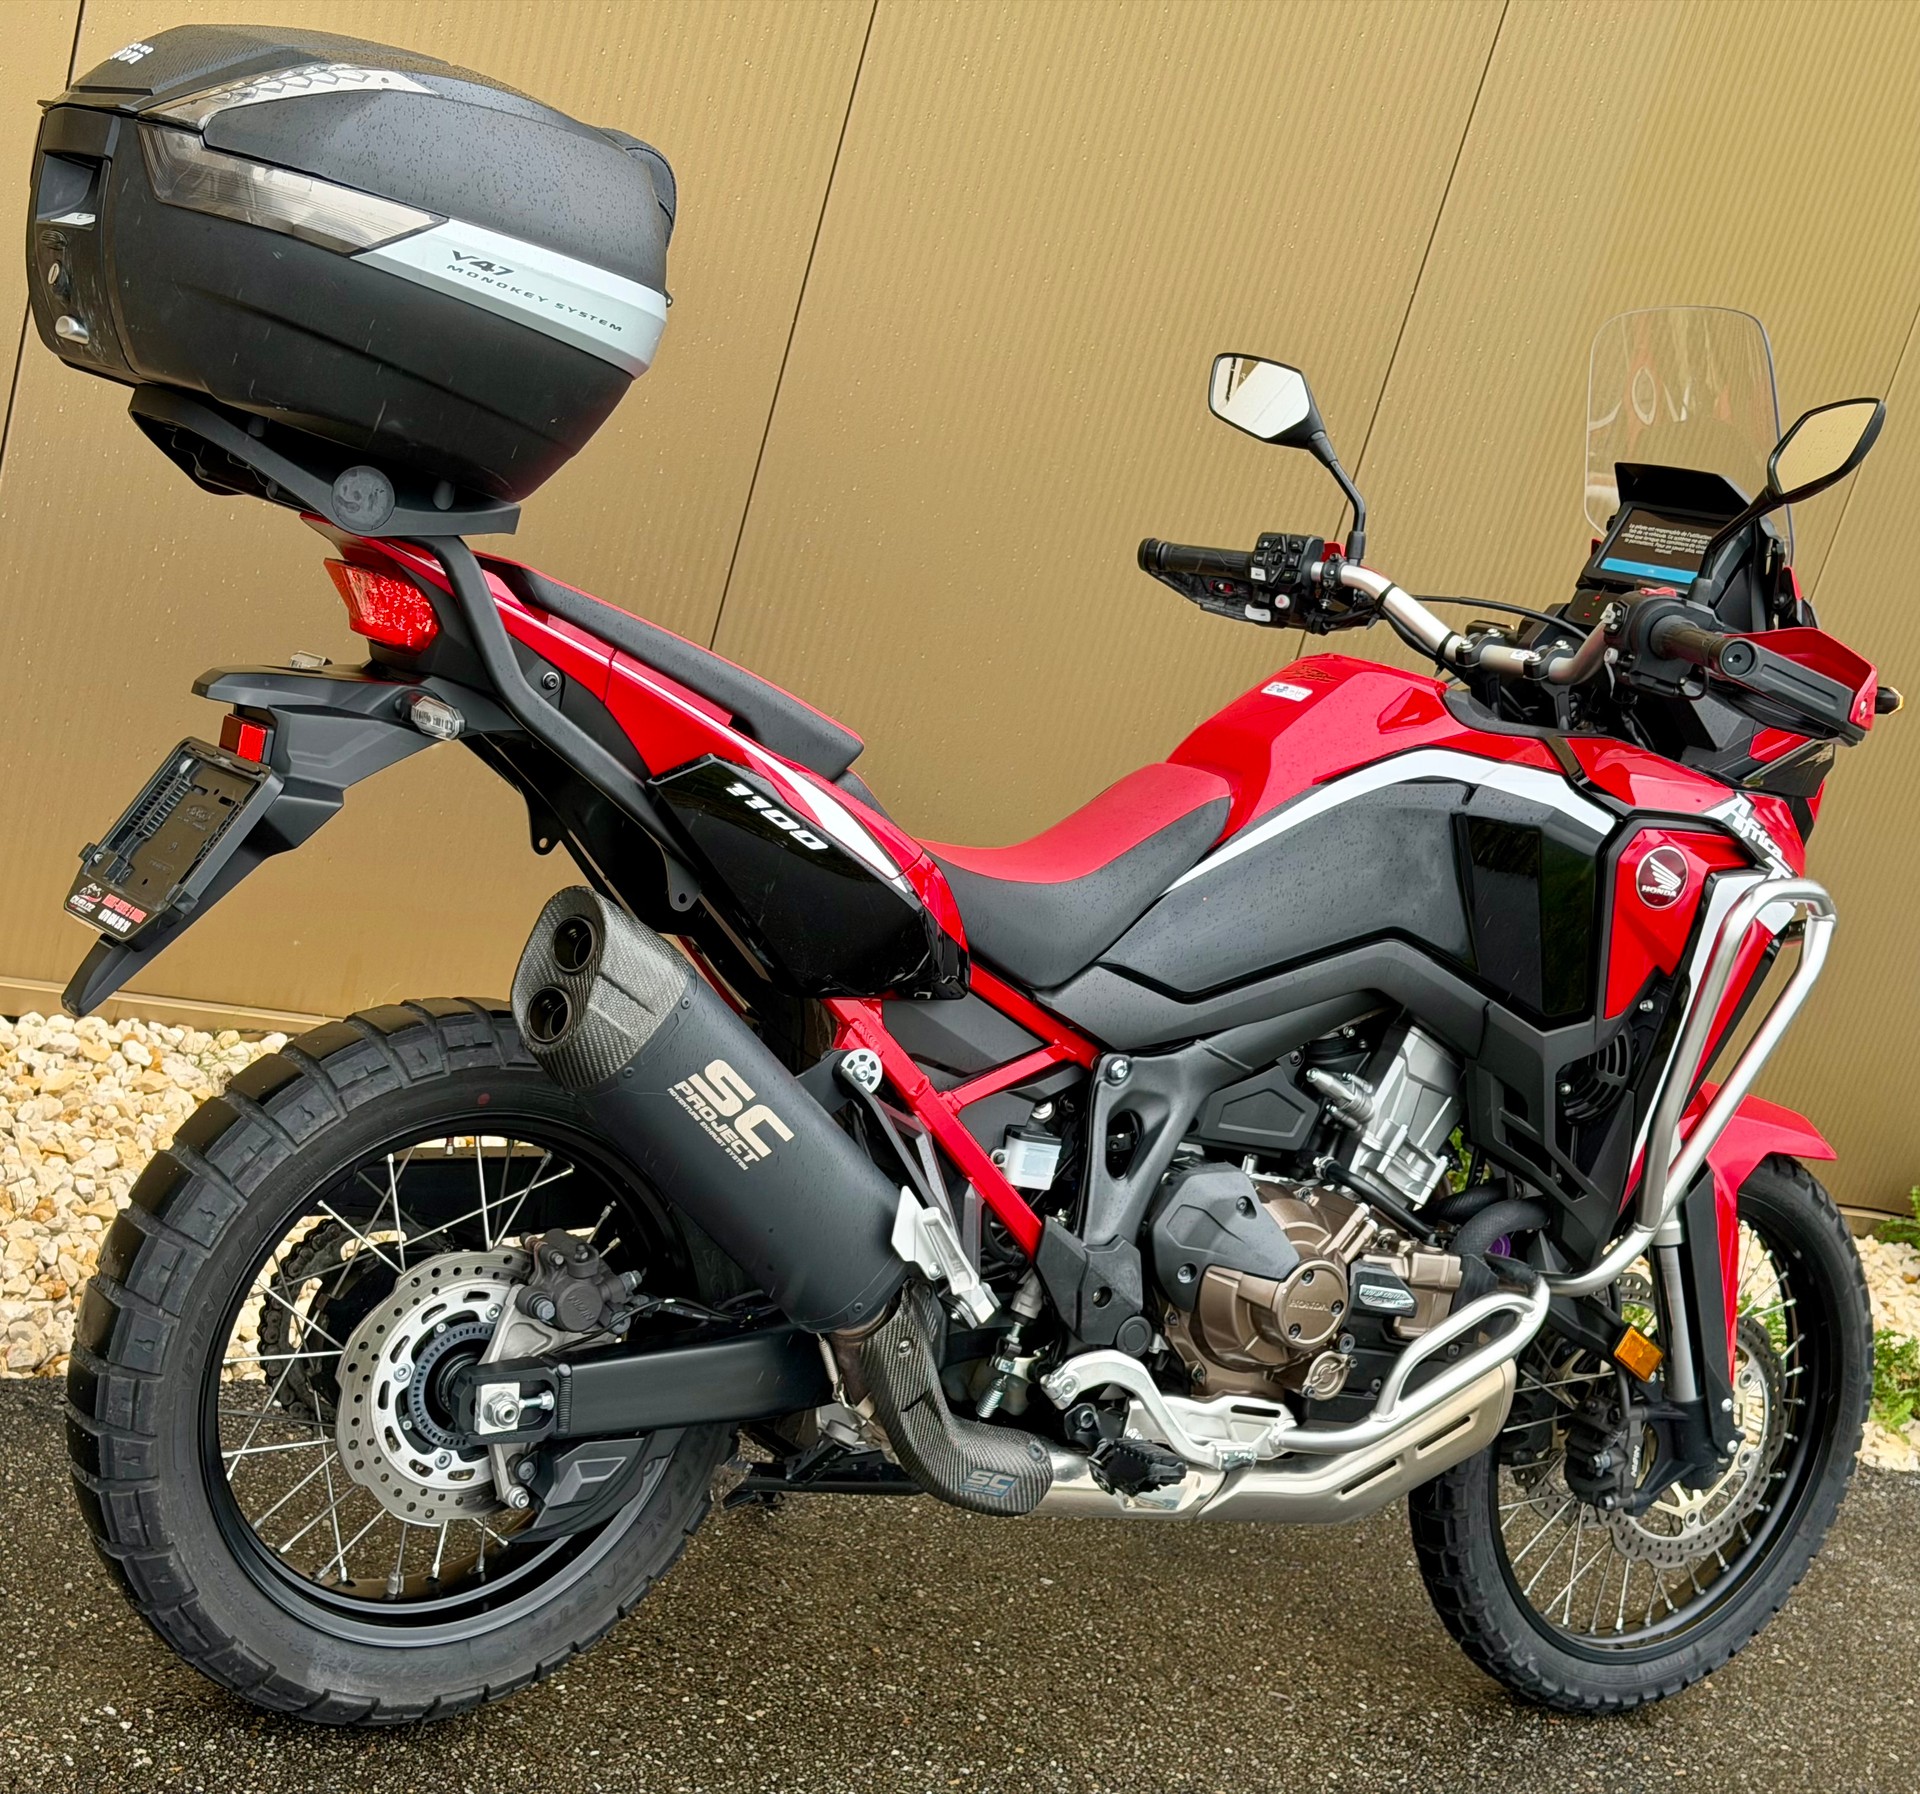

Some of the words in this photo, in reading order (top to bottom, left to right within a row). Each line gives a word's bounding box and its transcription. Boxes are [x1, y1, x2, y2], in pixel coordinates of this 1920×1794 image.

[452, 249, 515, 276] V47
[446, 264, 549, 303] MONOKEY
[554, 302, 622, 332] SYSTEM
[725, 782, 829, 850] 1100
[1703, 792, 1785, 861] Africa
[1641, 885, 1677, 898] HONDA
[667, 1087, 701, 1122] ADVENTURE
[700, 1121, 727, 1147] EXHAUST
[724, 1147, 749, 1171] SYSTEM
[673, 1080, 760, 1163] PROJECT
[687, 1059, 795, 1158] SC
[1288, 1299, 1329, 1312] HONDA
[966, 1469, 1016, 1490] SC
